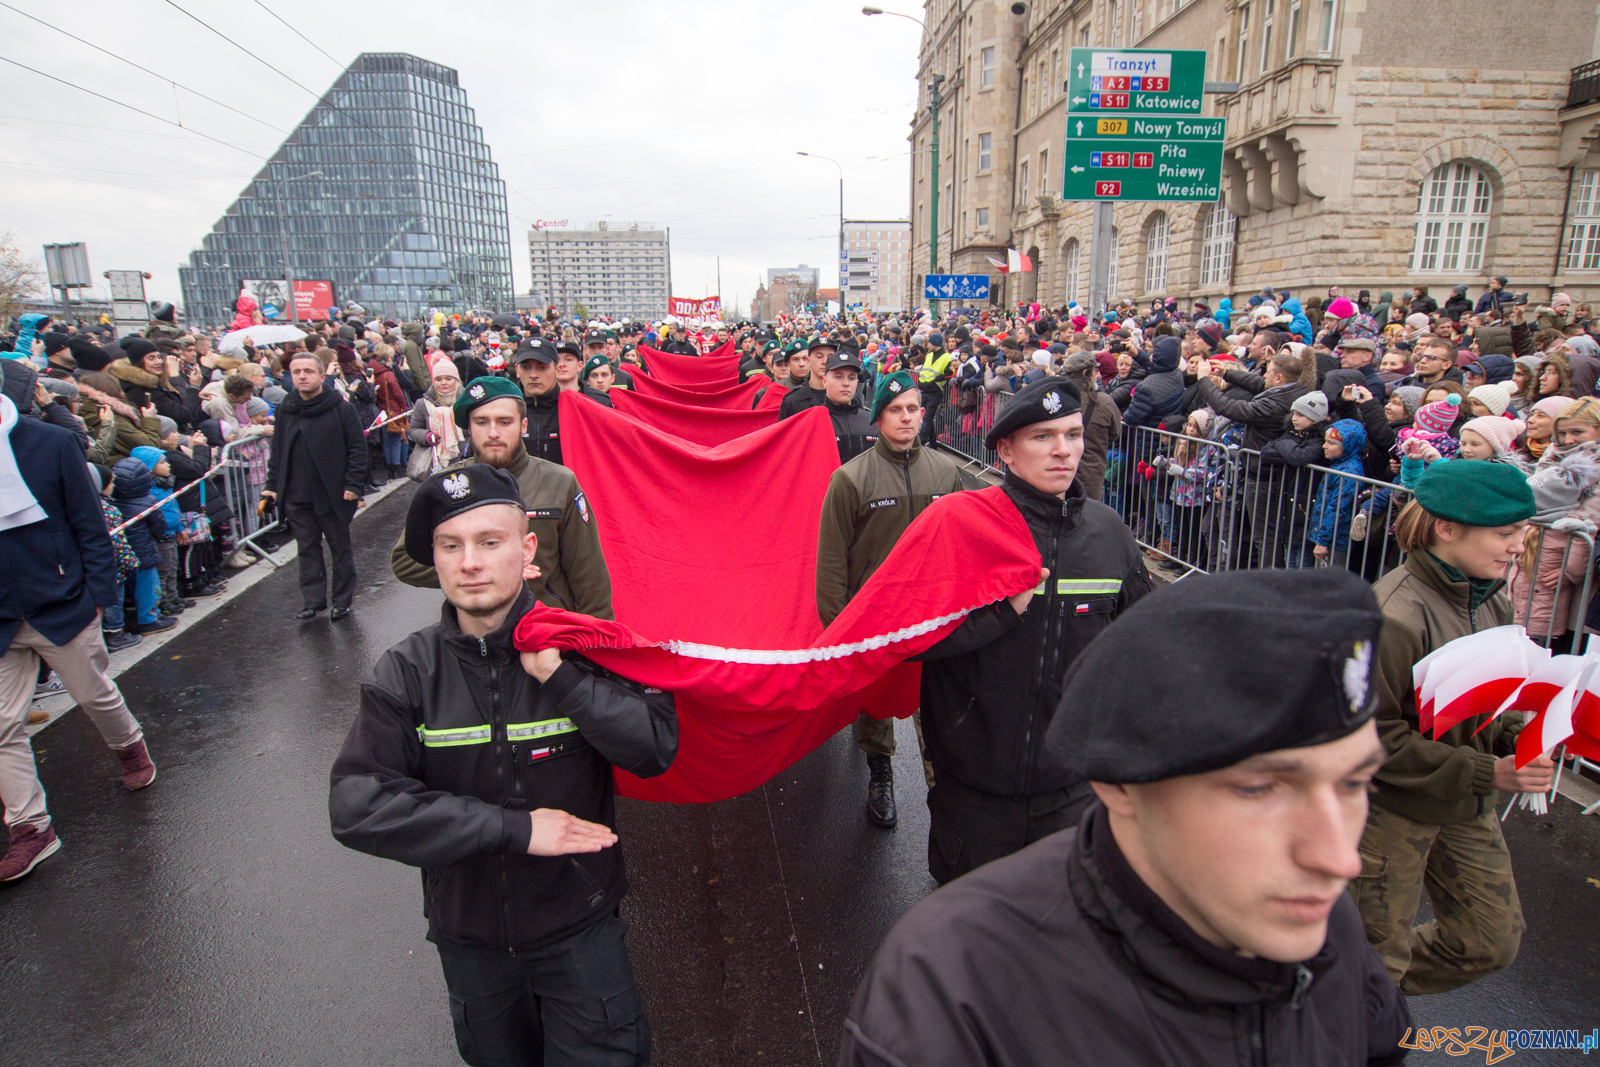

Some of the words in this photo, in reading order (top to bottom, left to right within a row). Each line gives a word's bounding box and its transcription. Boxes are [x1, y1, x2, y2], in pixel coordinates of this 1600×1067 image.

[1107, 57, 1156, 73] Tranzyt
[1107, 77, 1115, 89] A
[1118, 77, 1125, 89] 2
[1146, 78, 1153, 90] S
[1156, 78, 1164, 90] 5
[1105, 94, 1113, 106] S
[1115, 94, 1125, 106] 11
[1136, 94, 1200, 109] Katowice
[1102, 121, 1123, 132] 307
[1134, 120, 1172, 139] Nowy
[1176, 121, 1222, 139] Tomyśl
[1160, 144, 1187, 158] Piła
[1106, 154, 1114, 166] S
[1116, 154, 1125, 166] 11
[1138, 155, 1148, 166] 11
[1158, 163, 1206, 181] Pniewy
[1101, 183, 1115, 195] 92
[1156, 182, 1217, 196] Września
[536, 219, 566, 228] Centra
[877, 498, 896, 507] KRÓLIK
